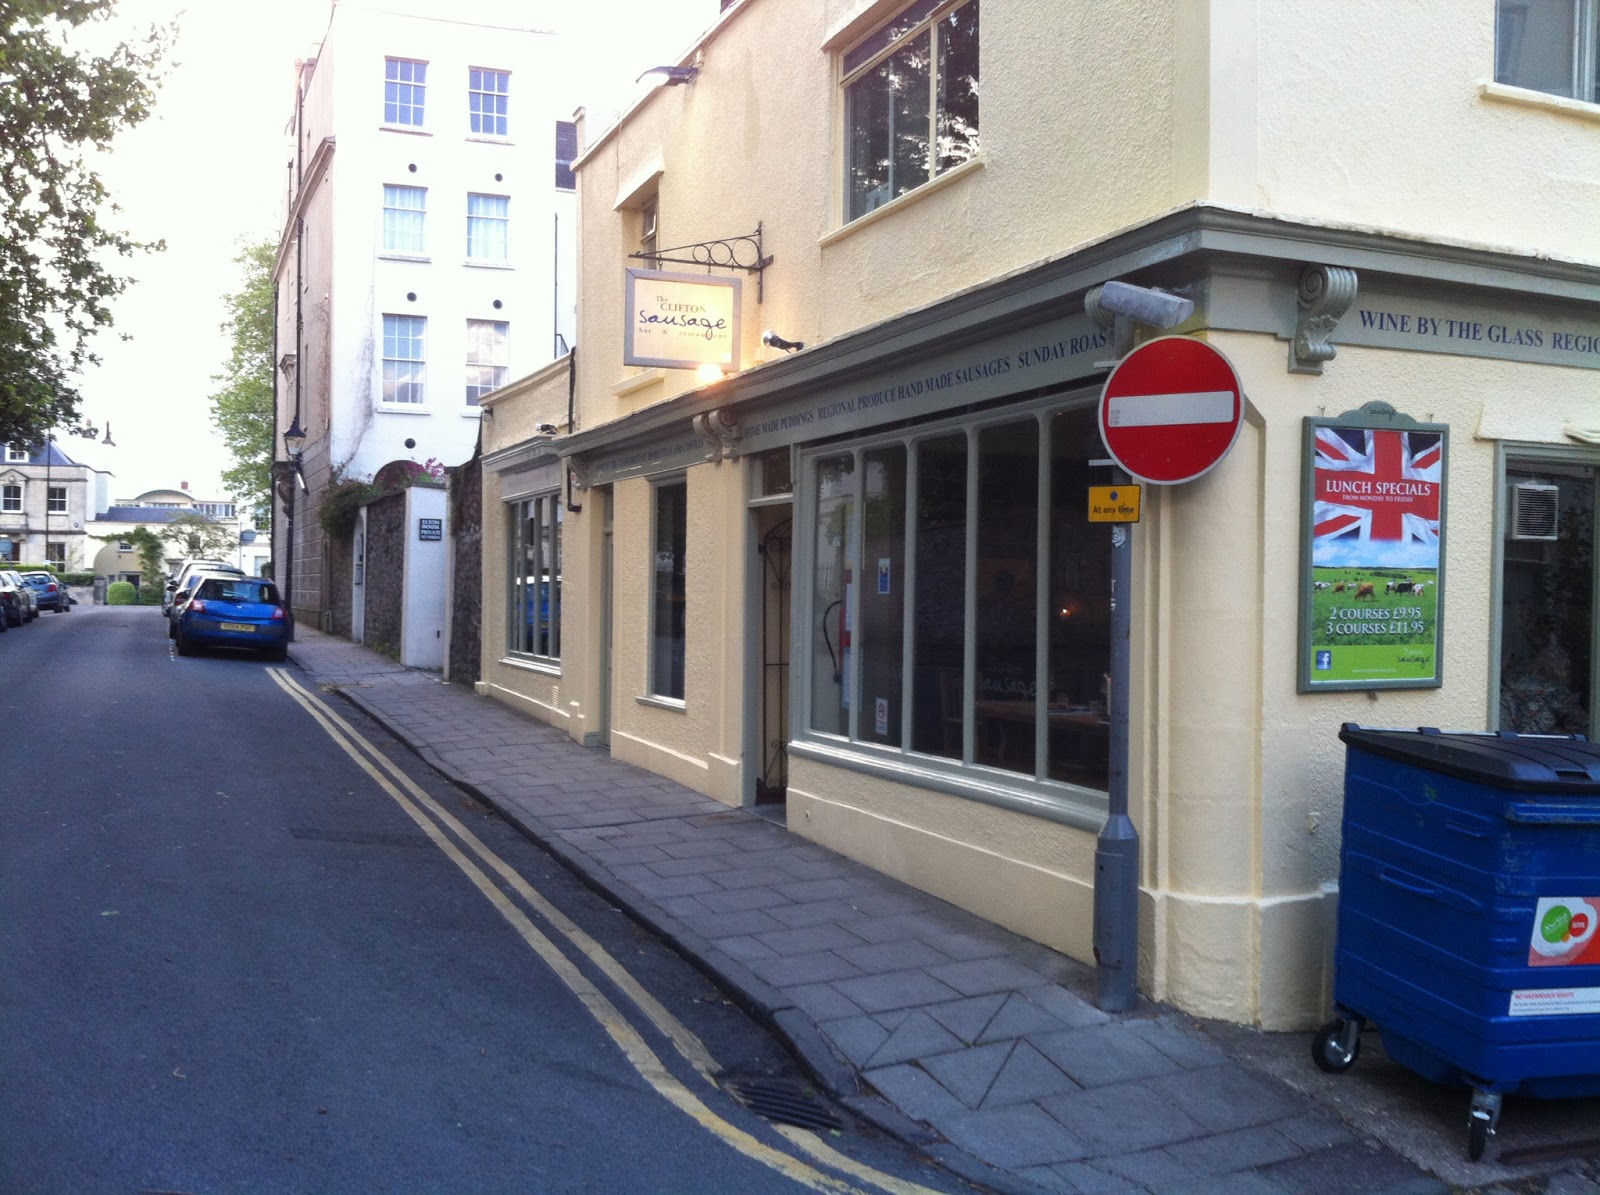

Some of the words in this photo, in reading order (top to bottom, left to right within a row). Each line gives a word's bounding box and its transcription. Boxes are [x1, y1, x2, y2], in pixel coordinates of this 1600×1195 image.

[660, 302, 707, 314] CLIFTON
[1359, 309, 1412, 333] WINE
[1417, 316, 1442, 336] BY
[1446, 319, 1483, 341] THE
[1488, 324, 1544, 348] GLASS
[762, 419, 780, 433] MADE
[780, 411, 814, 430] PUDDINGS
[817, 399, 859, 421] REGIONAL
[857, 387, 897, 411] PRODUCE
[898, 380, 924, 400] HAND
[925, 371, 954, 393] MADE
[955, 356, 1011, 385] SAUSAGES
[1018, 340, 1068, 369] SUNDAY
[1070, 331, 1108, 356] ROAS
[1326, 479, 1372, 494] LUNCH
[1375, 482, 1431, 496] SPECIALS
[1385, 495, 1394, 503] TO
[1093, 505, 1102, 514] At
[1103, 507, 1117, 516] any
[1329, 606, 1337, 620] 2
[1339, 608, 1390, 620] COURSES
[1392, 606, 1421, 620] £9.95
[1325, 621, 1333, 635] 3
[1336, 623, 1387, 635] COURSES
[1389, 621, 1425, 635] £11.95
